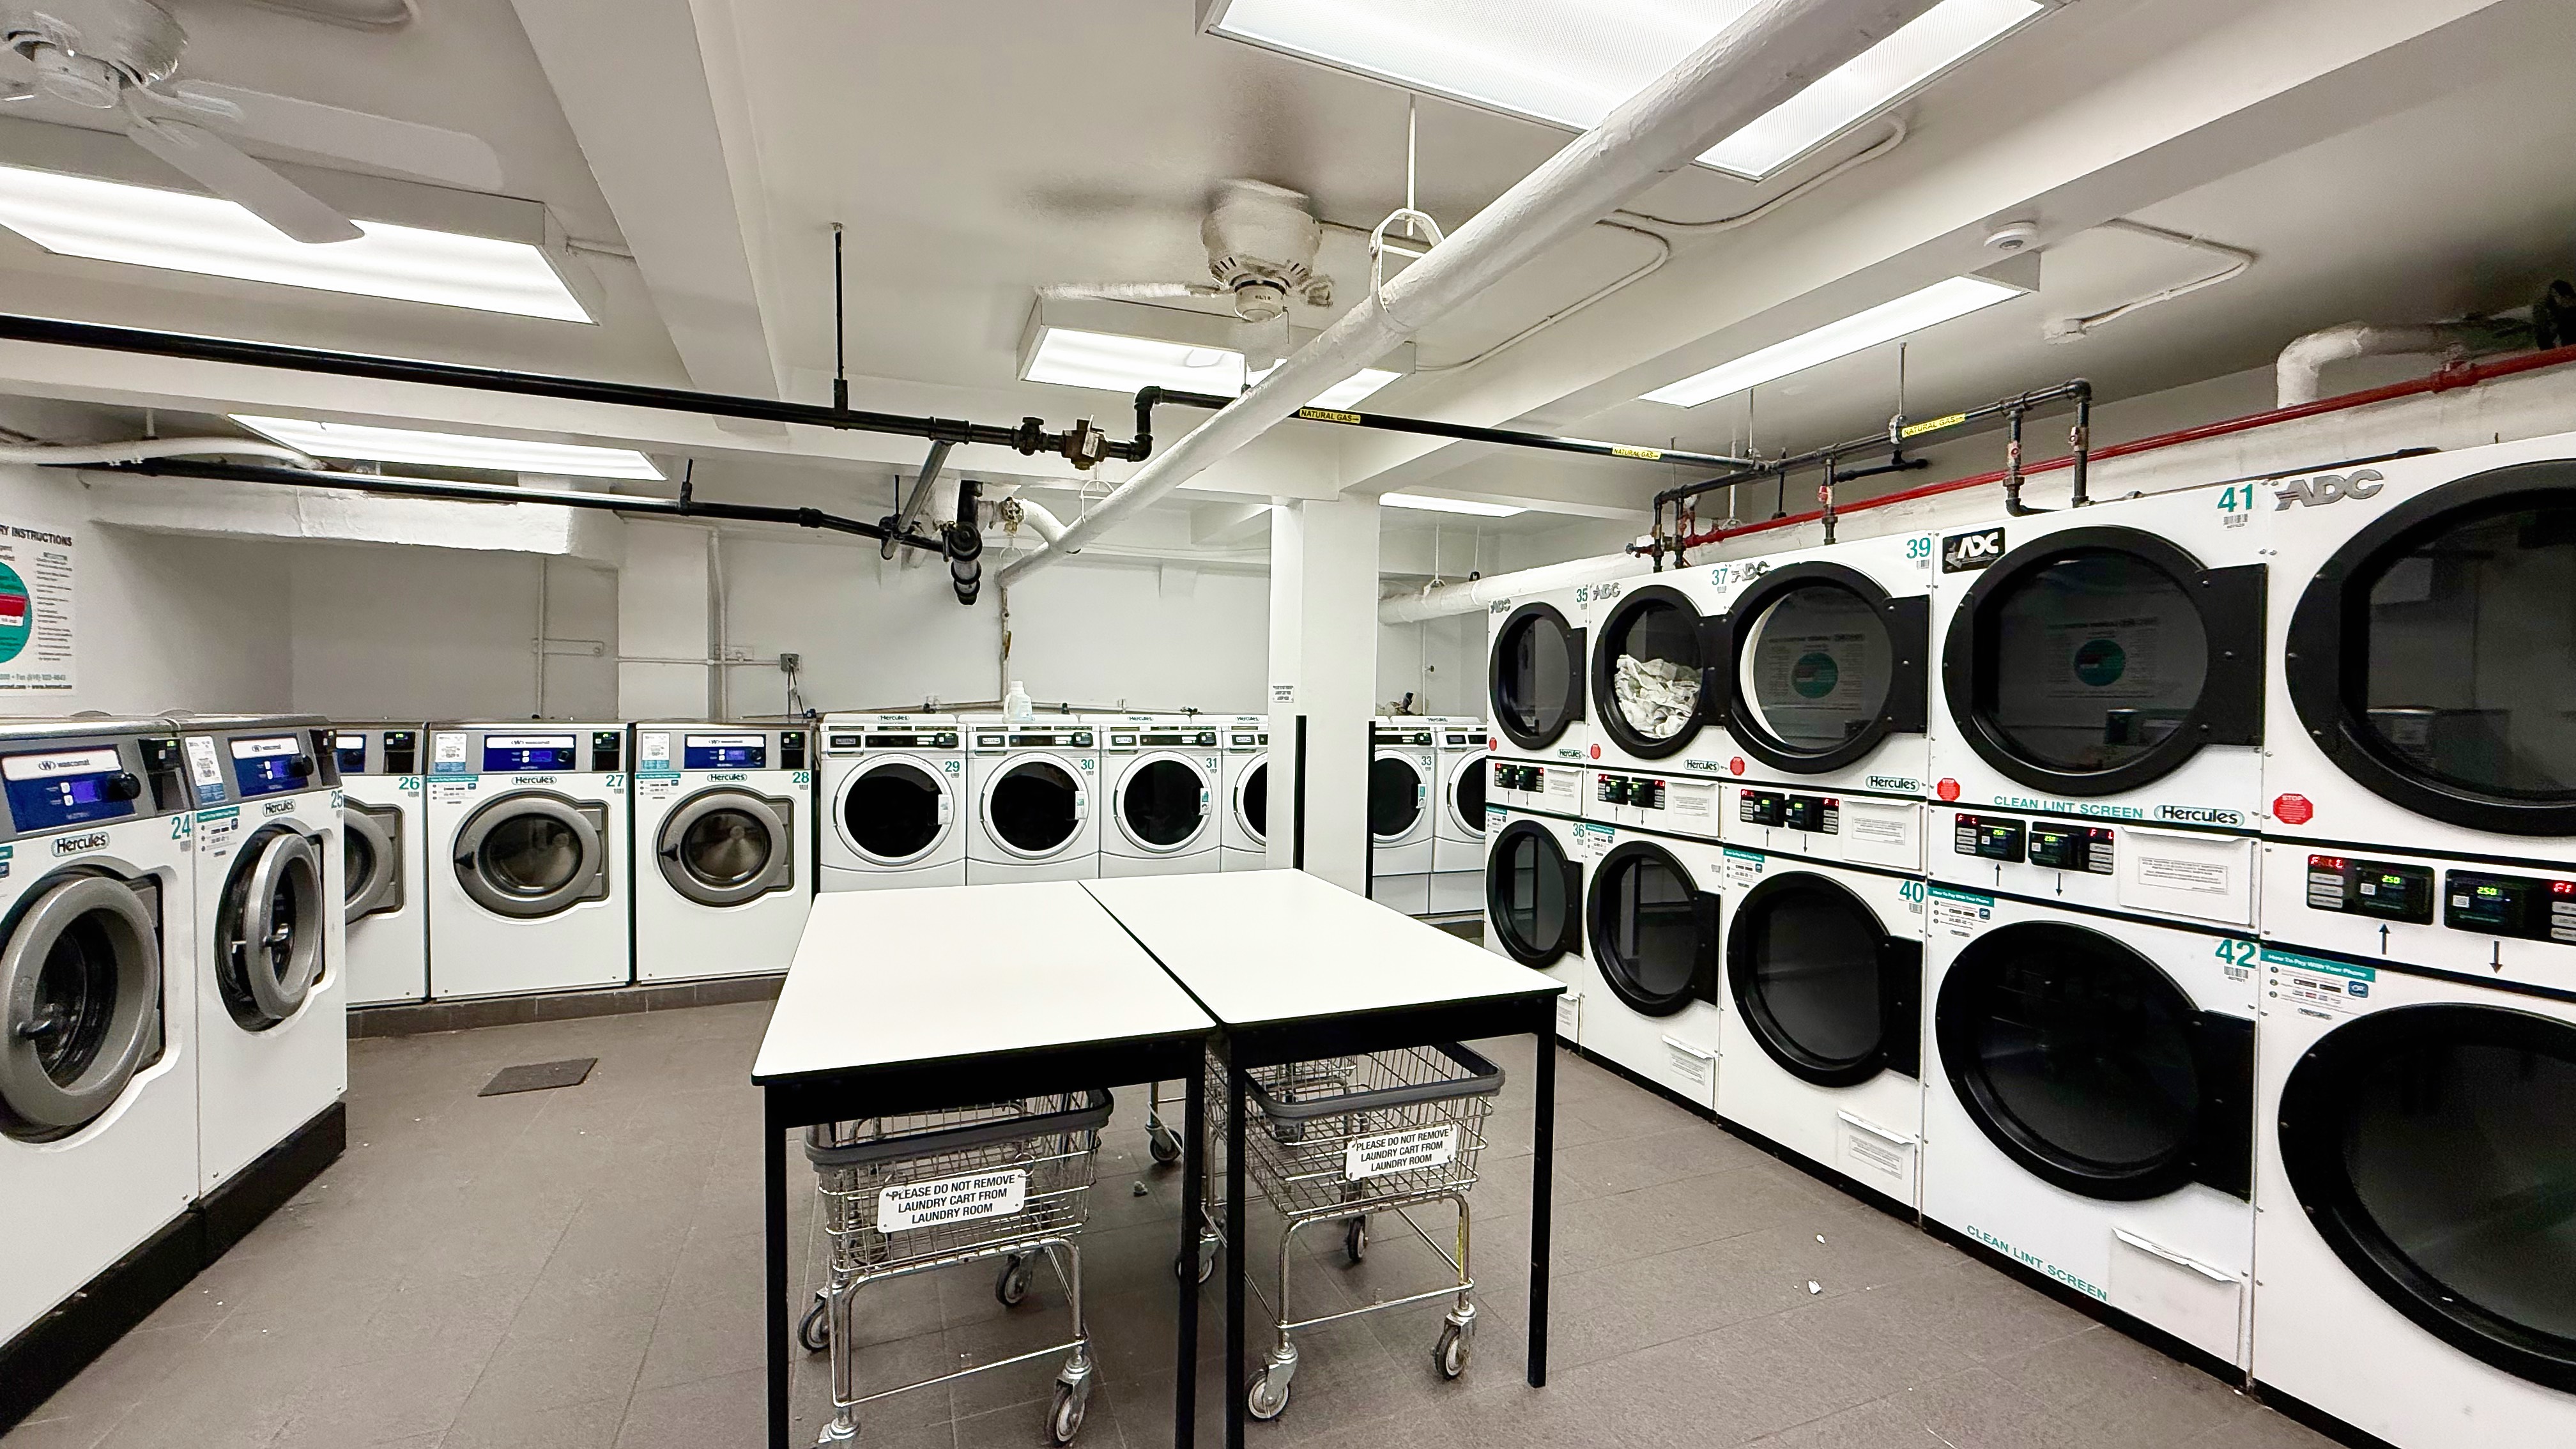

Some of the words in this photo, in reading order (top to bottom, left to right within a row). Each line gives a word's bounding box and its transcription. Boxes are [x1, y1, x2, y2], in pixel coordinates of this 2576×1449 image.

[1301, 410, 1335, 420] NATURAL
[1904, 421, 1937, 436] NATURAL
[1939, 417, 1955, 426] GAS
[1614, 449, 1639, 457] NATURAL
[2217, 483, 2253, 512] 41
[2274, 469, 2384, 511] ADC
[12, 526, 72, 547] INSTRUCTIONS
[1957, 532, 1998, 559] ADC
[1906, 537, 1931, 559] 39
[1712, 567, 1728, 585] 37
[1576, 588, 1588, 602] 35
[1593, 582, 1621, 601] ADC
[1491, 598, 1511, 614] ADC
[1421, 756, 1432, 766] 33
[1559, 749, 1581, 758] Hercules
[945, 761, 960, 772] 29
[1080, 759, 1094, 770] 30
[1206, 758, 1217, 769] 31
[1687, 760, 1717, 770] Hercules
[399, 776, 420, 790] 26
[606, 775, 624, 787] 27
[792, 772, 809, 783] 28
[1870, 776, 1916, 790] Hercules
[264, 799, 295, 815] Hercules
[331, 790, 343, 809] 25
[1994, 796, 2039, 809] CLEAN
[2044, 801, 2075, 813] LINT
[2080, 804, 2143, 818] SCREEN
[2163, 806, 2238, 825] Hercules
[171, 815, 191, 840] 24
[1572, 823, 1584, 838] 36
[56, 834, 106, 854] Hercules
[2382, 875, 2401, 884] 250
[1899, 880, 1924, 903] 40
[2477, 886, 2498, 896] 250
[2215, 939, 2256, 969] 42
[2343, 968, 2366, 977] Phone
[1356, 1138, 1386, 1152] PLEASE
[1388, 1136, 1399, 1146] DO
[1400, 1133, 1416, 1144] NOT
[1418, 1128, 1449, 1142] REMOVE
[1361, 1148, 1398, 1162] LAUNDRY
[1399, 1144, 1420, 1156] CART
[1422, 1141, 1443, 1152] FROM
[1371, 1158, 1407, 1172] LAUNDRY
[1409, 1154, 1432, 1165] ROOM
[891, 1186, 931, 1201] PLEASE
[933, 1184, 948, 1195] DO
[951, 1181, 971, 1192] NOT
[974, 1174, 1015, 1189] REMOVE
[898, 1197, 947, 1213] LAUNDRY
[949, 1193, 976, 1205] CART
[978, 1188, 1007, 1202] FROM
[912, 1208, 960, 1224] LAUNDRY
[963, 1203, 993, 1216] ROOM
[1967, 1225, 2009, 1252] CLEAN
[2013, 1247, 2043, 1269] LINT
[2047, 1264, 2107, 1301] SCREEN
